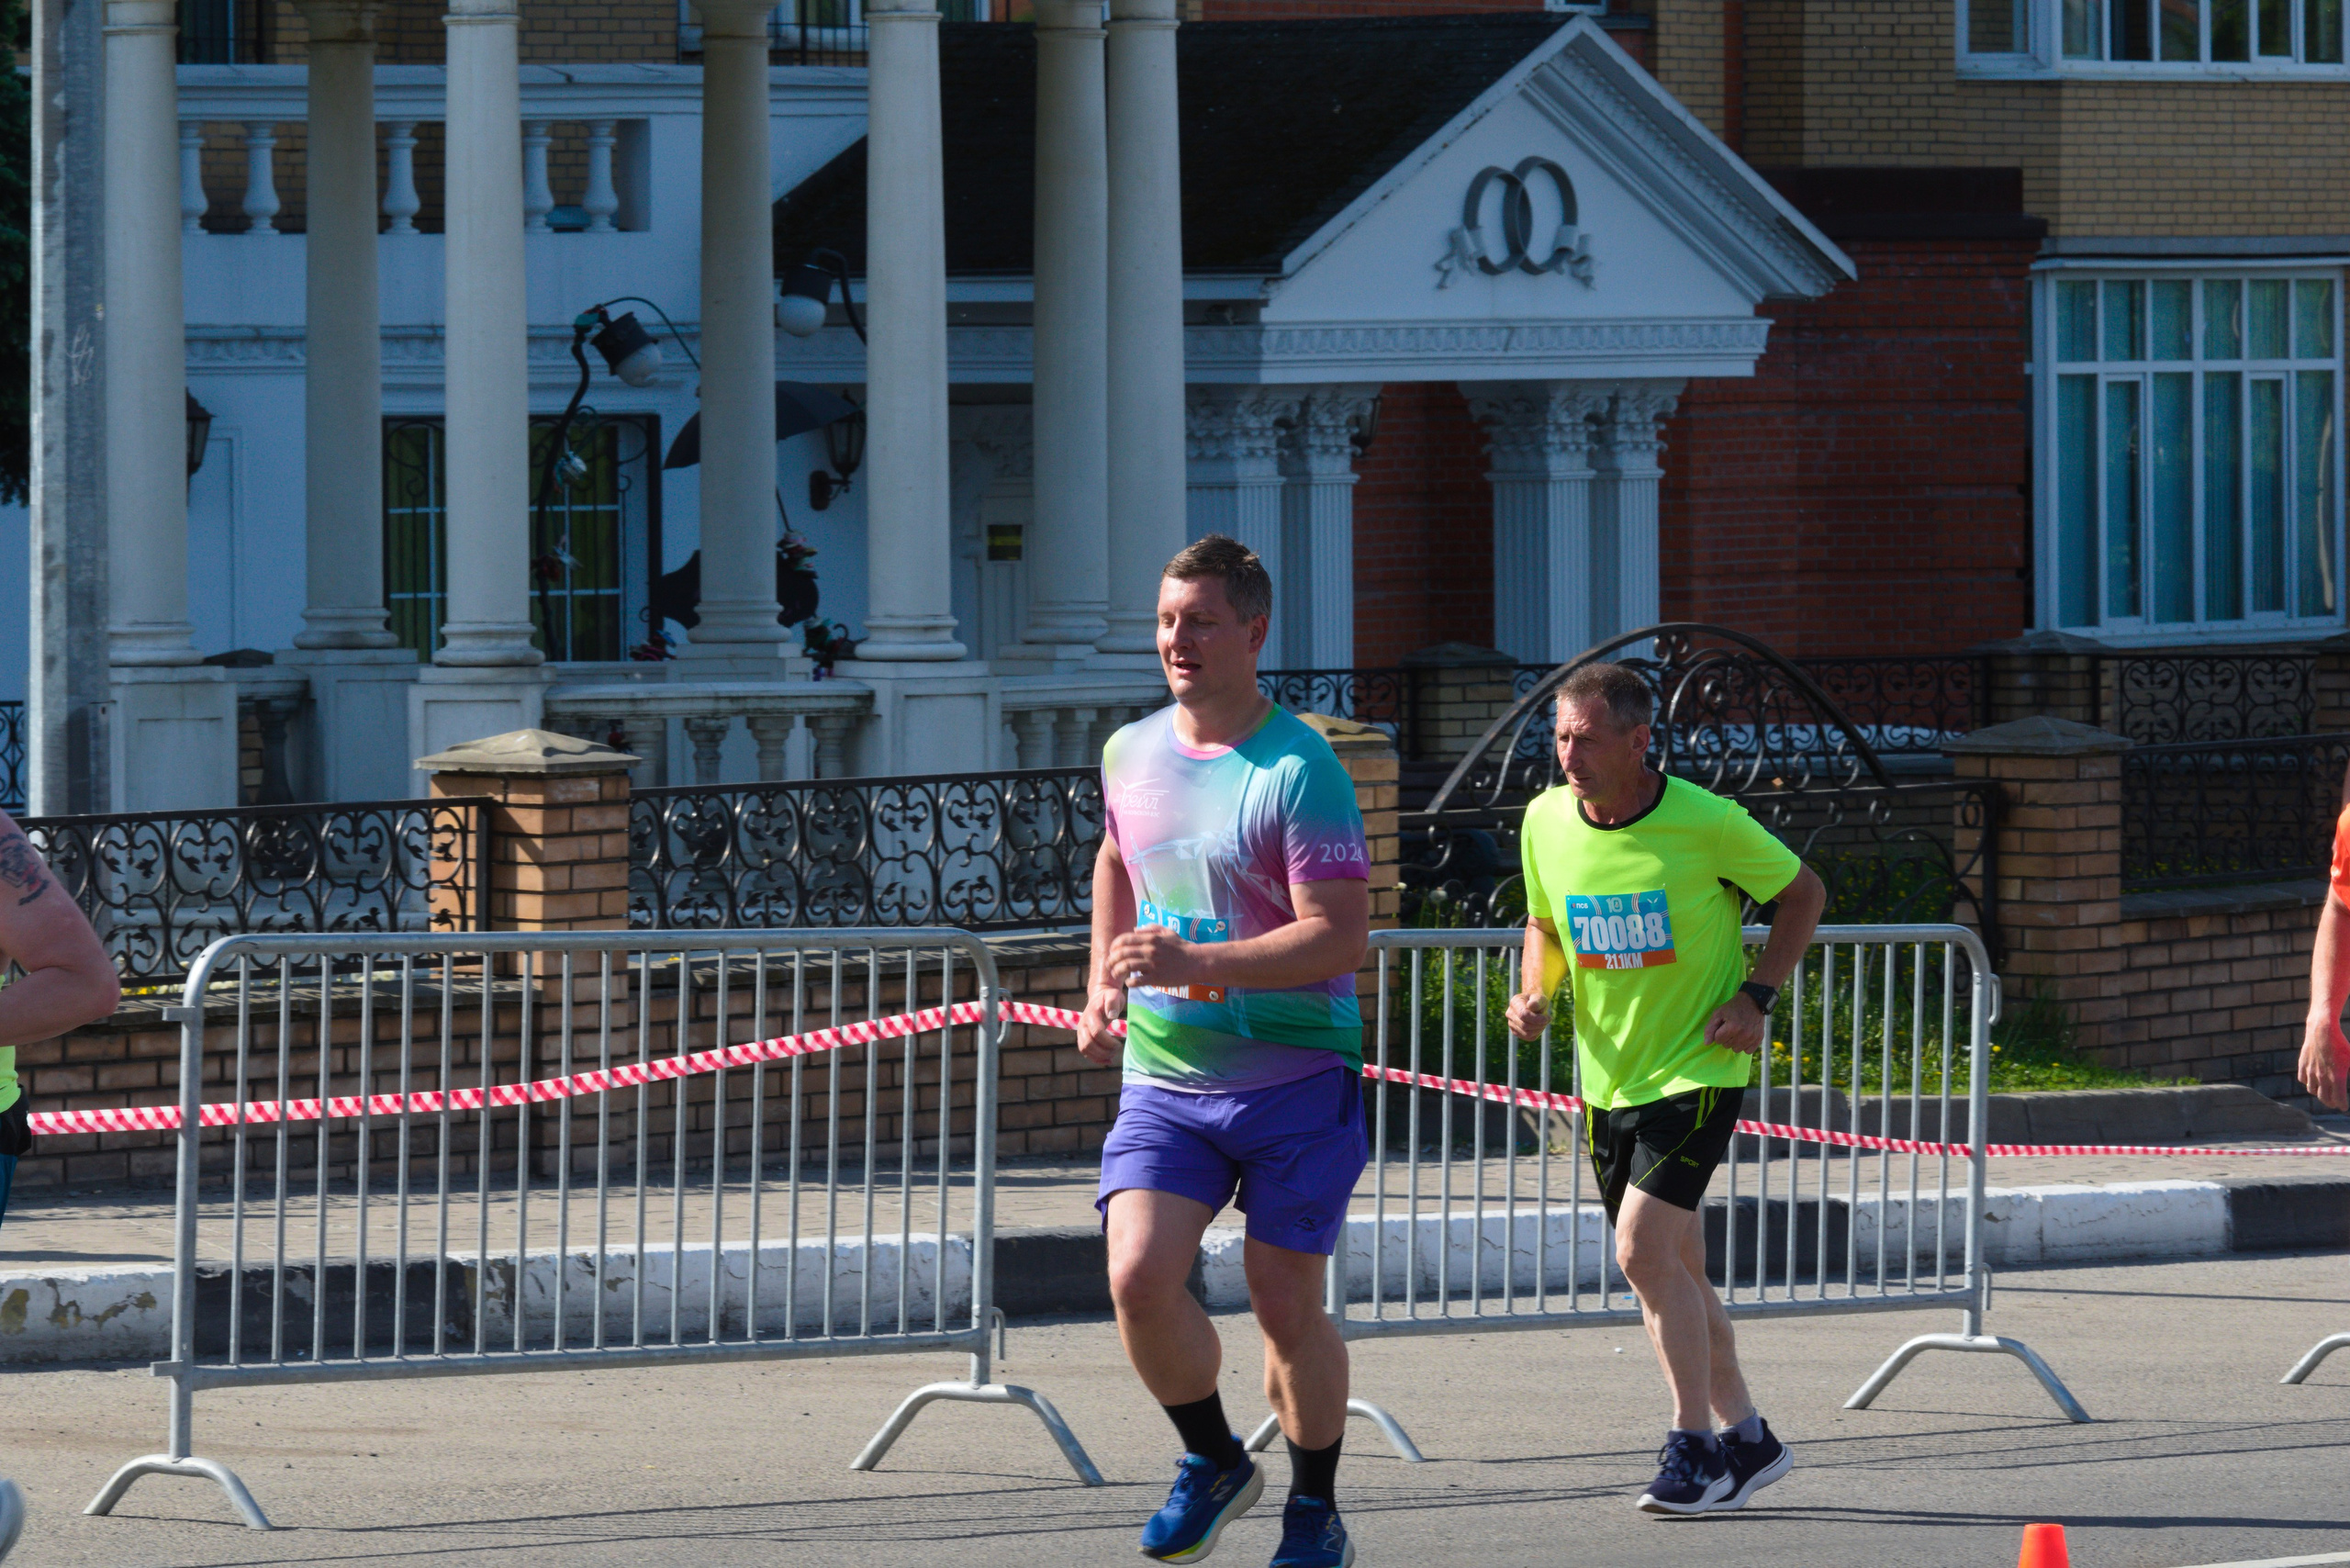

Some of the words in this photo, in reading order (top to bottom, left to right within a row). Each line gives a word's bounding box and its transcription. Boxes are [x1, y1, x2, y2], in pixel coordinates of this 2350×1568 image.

[1319, 842, 1364, 864] 2024
[1572, 912, 1666, 951] 70088
[1680, 1155, 1699, 1168] SPORT
